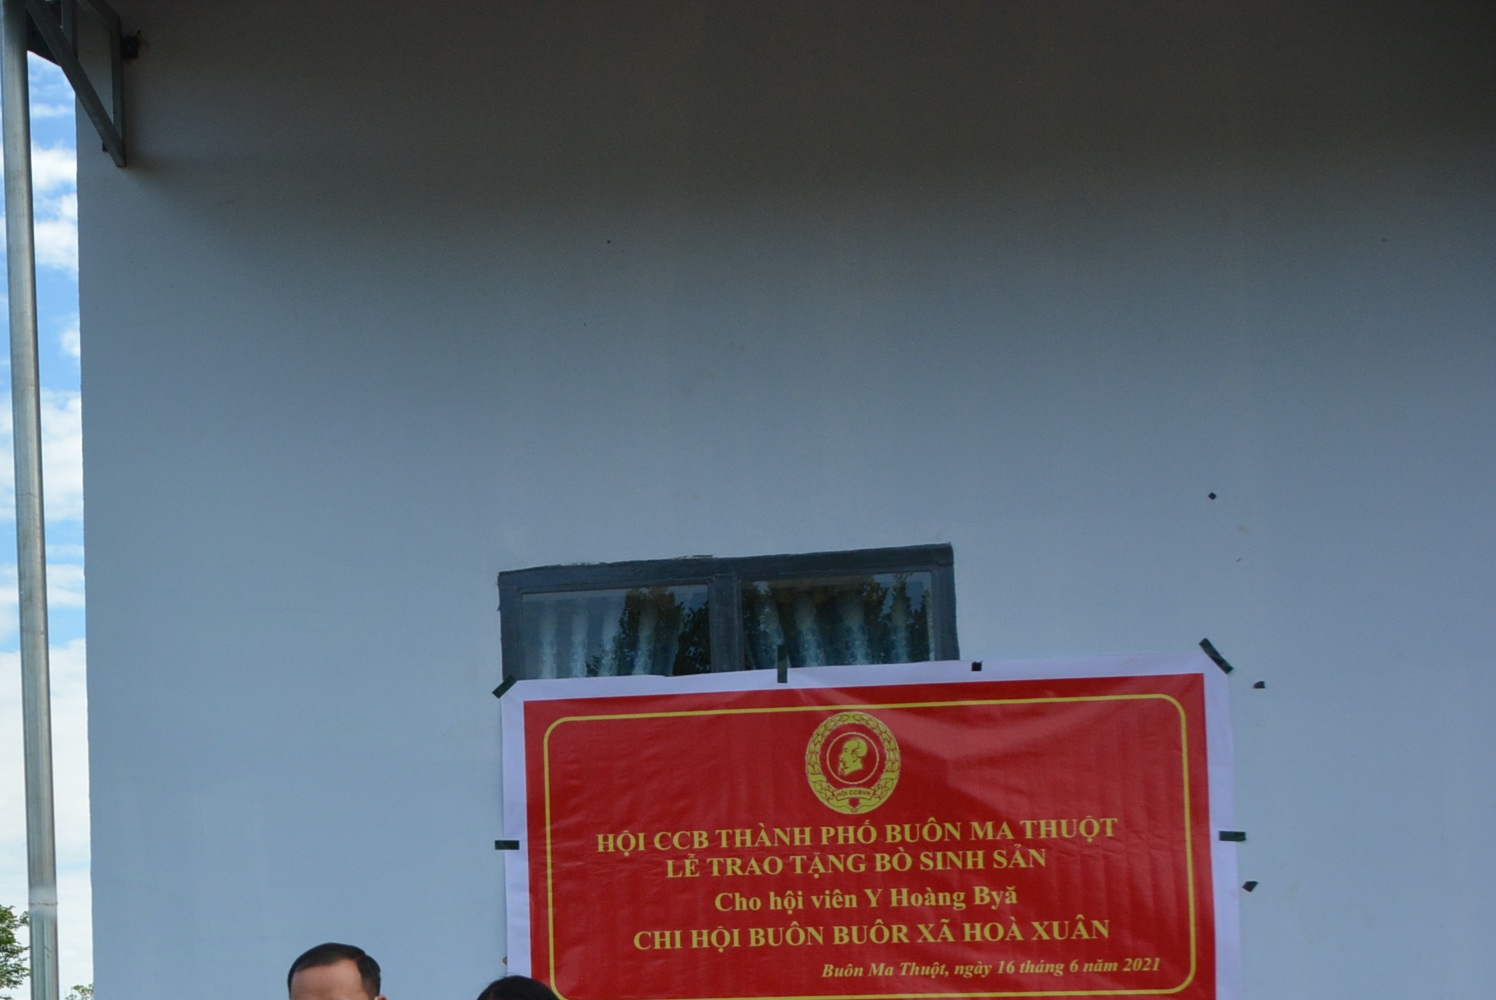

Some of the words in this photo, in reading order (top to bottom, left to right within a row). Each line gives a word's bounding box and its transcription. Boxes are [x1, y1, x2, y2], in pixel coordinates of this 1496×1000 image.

[596, 829, 646, 857] HỘI
[654, 829, 709, 851] CCB
[715, 822, 813, 849] THÀNH
[820, 819, 878, 846] PHỐ
[885, 816, 962, 844] BUÔN
[970, 821, 1015, 841] MA
[1019, 814, 1118, 843] THUỘT
[665, 853, 701, 879] LỄ
[707, 856, 784, 877] TRAO
[790, 851, 866, 879] TẶNG
[874, 847, 913, 873] BÒ
[919, 850, 985, 871] SINH
[993, 843, 1047, 869] SẢN
[714, 892, 762, 912] Cho
[769, 890, 804, 915] hội
[811, 889, 858, 909] viên
[864, 888, 883, 907] Y
[890, 886, 966, 911] Hoàng
[973, 885, 1018, 910] Byă
[633, 930, 683, 950] CHI
[691, 926, 741, 953] HỘI
[749, 920, 824, 947] BUÔN
[832, 918, 911, 945] BUÔR
[916, 918, 955, 943] XÃ
[962, 916, 1024, 943] HOÀ
[1031, 913, 1110, 941] XUÂN
[822, 963, 864, 978] Buôn
[868, 963, 894, 977] Ma
[899, 962, 949, 979] Thuột,
[954, 961, 992, 978] ngày
[997, 960, 1015, 975] 16
[1019, 959, 1064, 976] tháng
[1069, 959, 1079, 973] 6
[1083, 958, 1118, 973] năm
[1122, 957, 1161, 972] 2021
